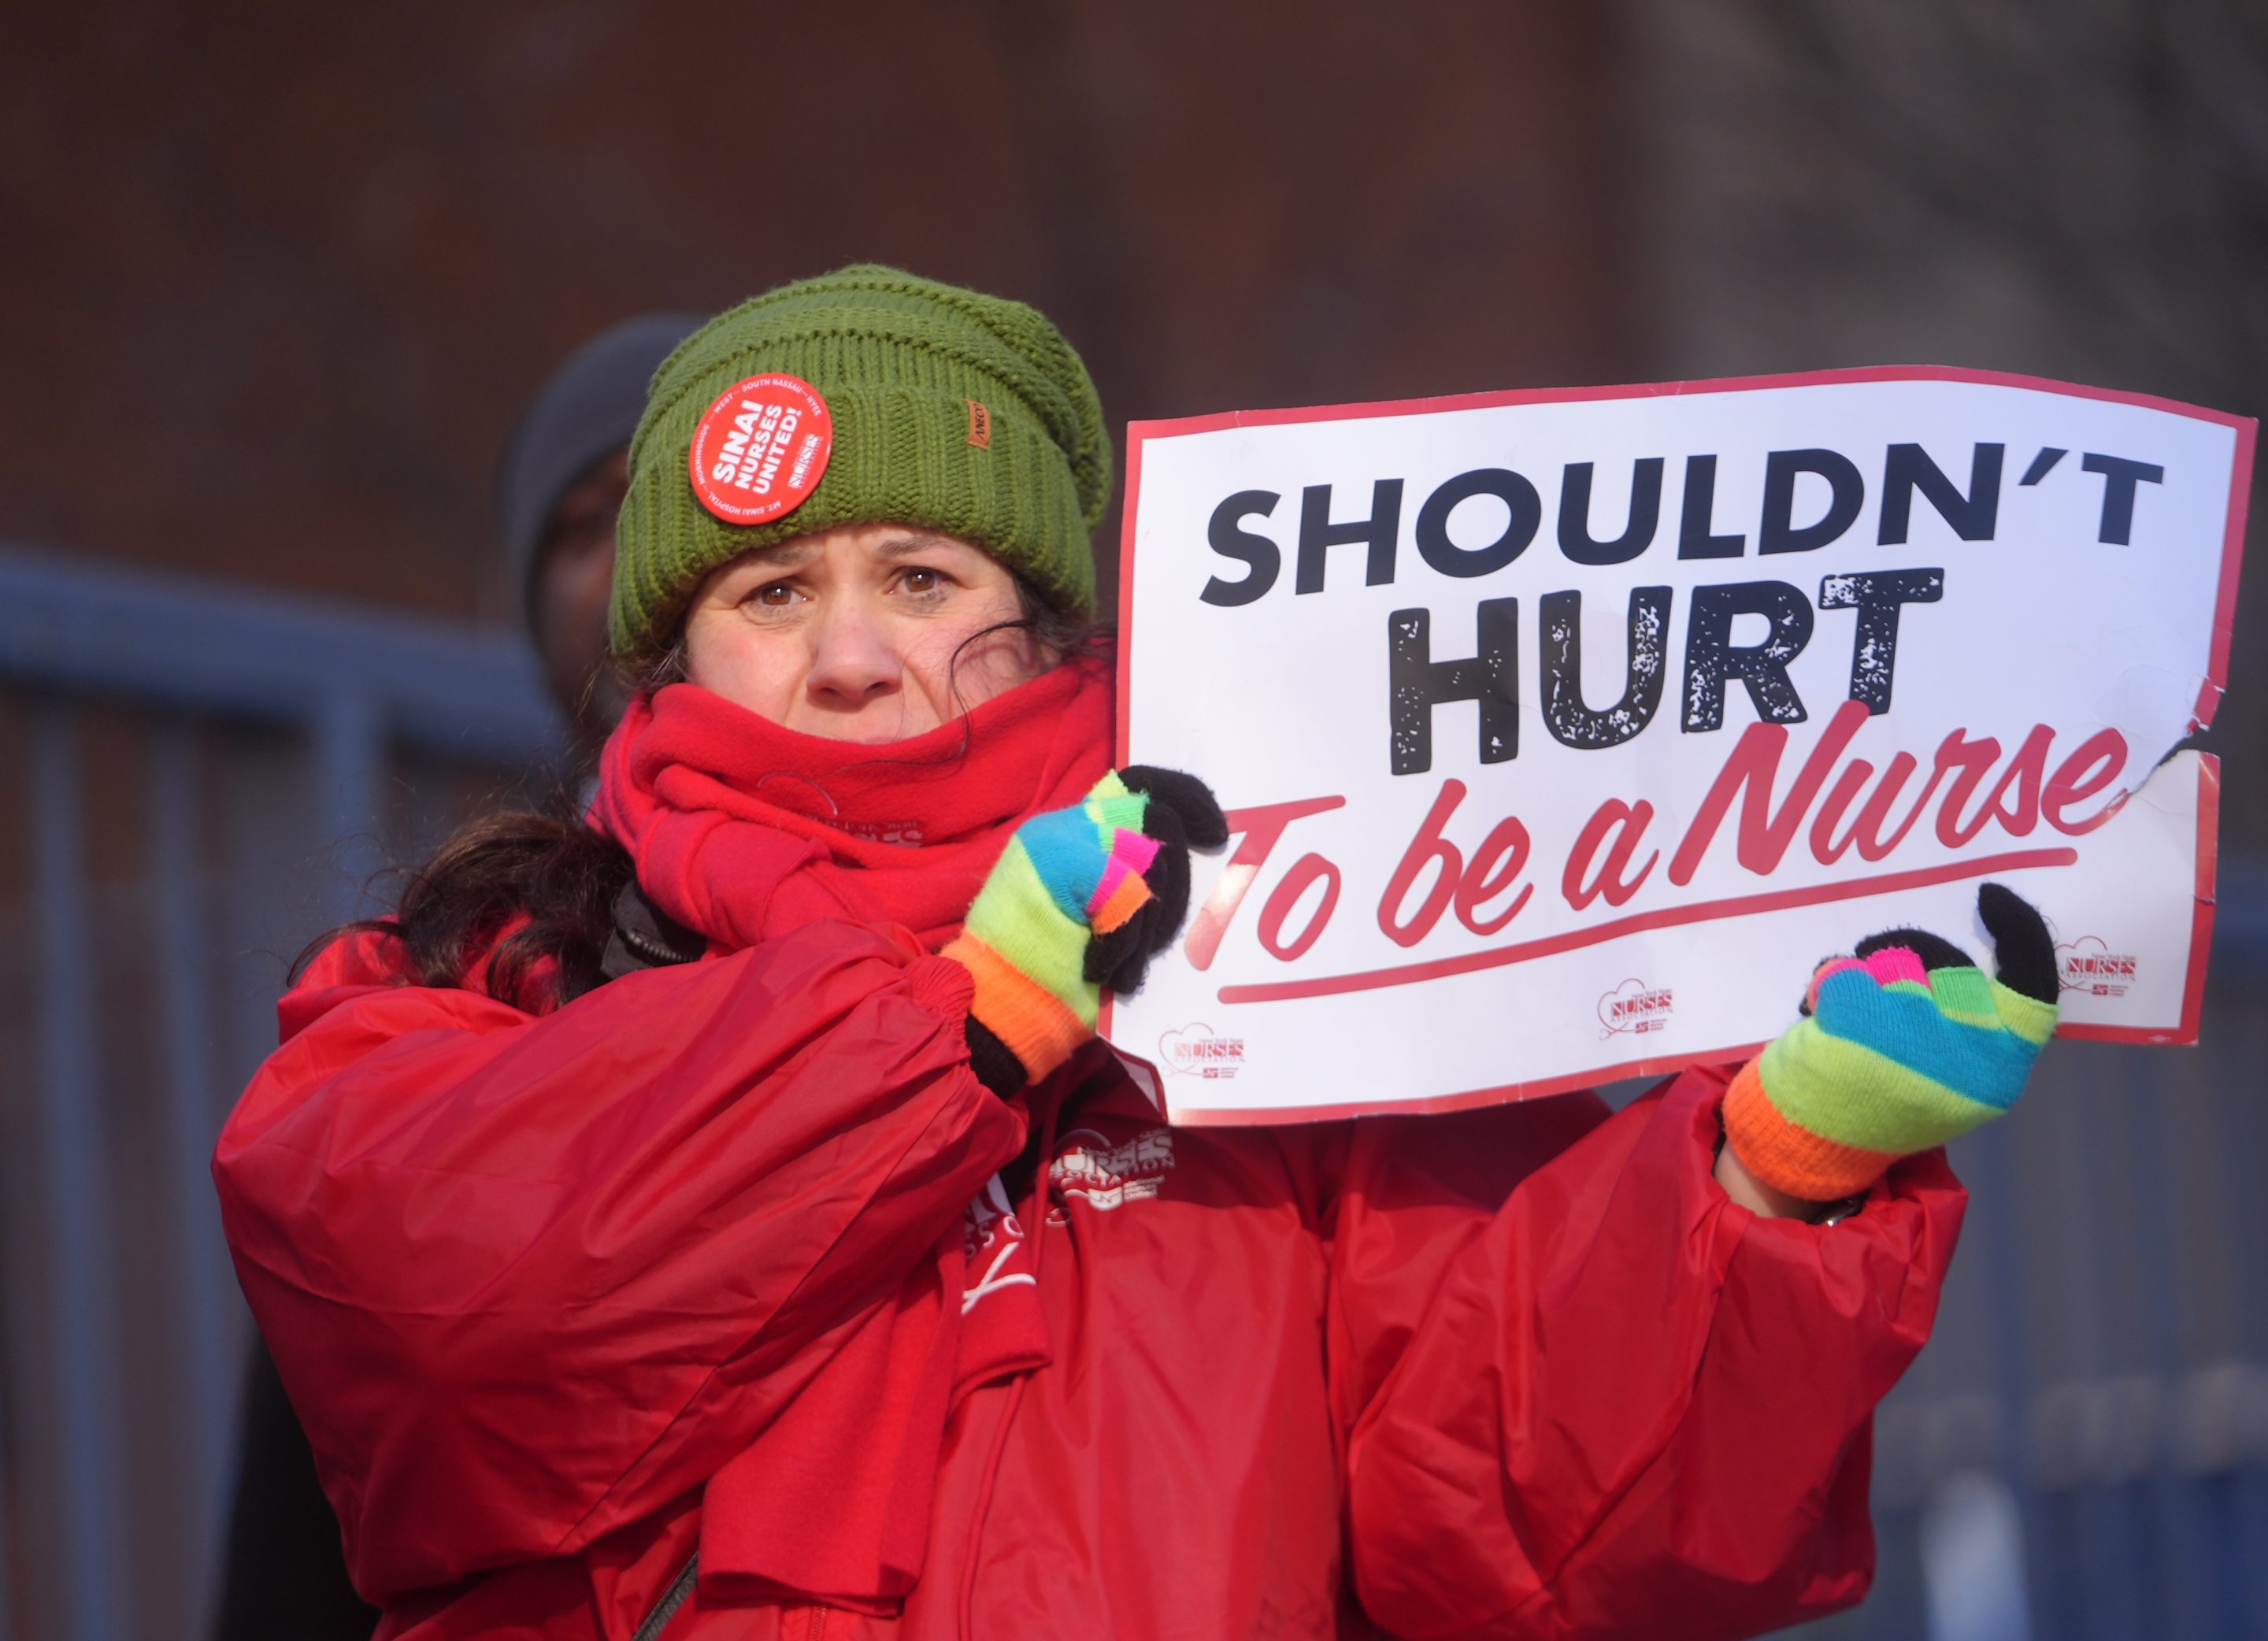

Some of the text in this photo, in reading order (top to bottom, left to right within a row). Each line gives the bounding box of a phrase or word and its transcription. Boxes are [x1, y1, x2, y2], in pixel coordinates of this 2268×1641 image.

[742, 378, 771, 392] SOUTH
[771, 378, 803, 394] NASSAU
[713, 393, 734, 414] WEST
[695, 424, 710, 486] MORNINGSIDE
[712, 399, 764, 484] SINAI
[734, 404, 783, 490] NURSES
[752, 406, 802, 495] UNITED!
[708, 491, 742, 515] HOSPITAL
[742, 506, 765, 516] SINAI
[1199, 442, 2165, 608] SHOULDN'T
[1388, 567, 1944, 776] HURT
[1184, 699, 2129, 972] To be a Nurse
[2067, 958, 2136, 975] NURSES
[1610, 994, 1672, 1017] NURSES
[1174, 1043, 1244, 1058] NURSES
[1050, 1135, 1172, 1178] URSES
